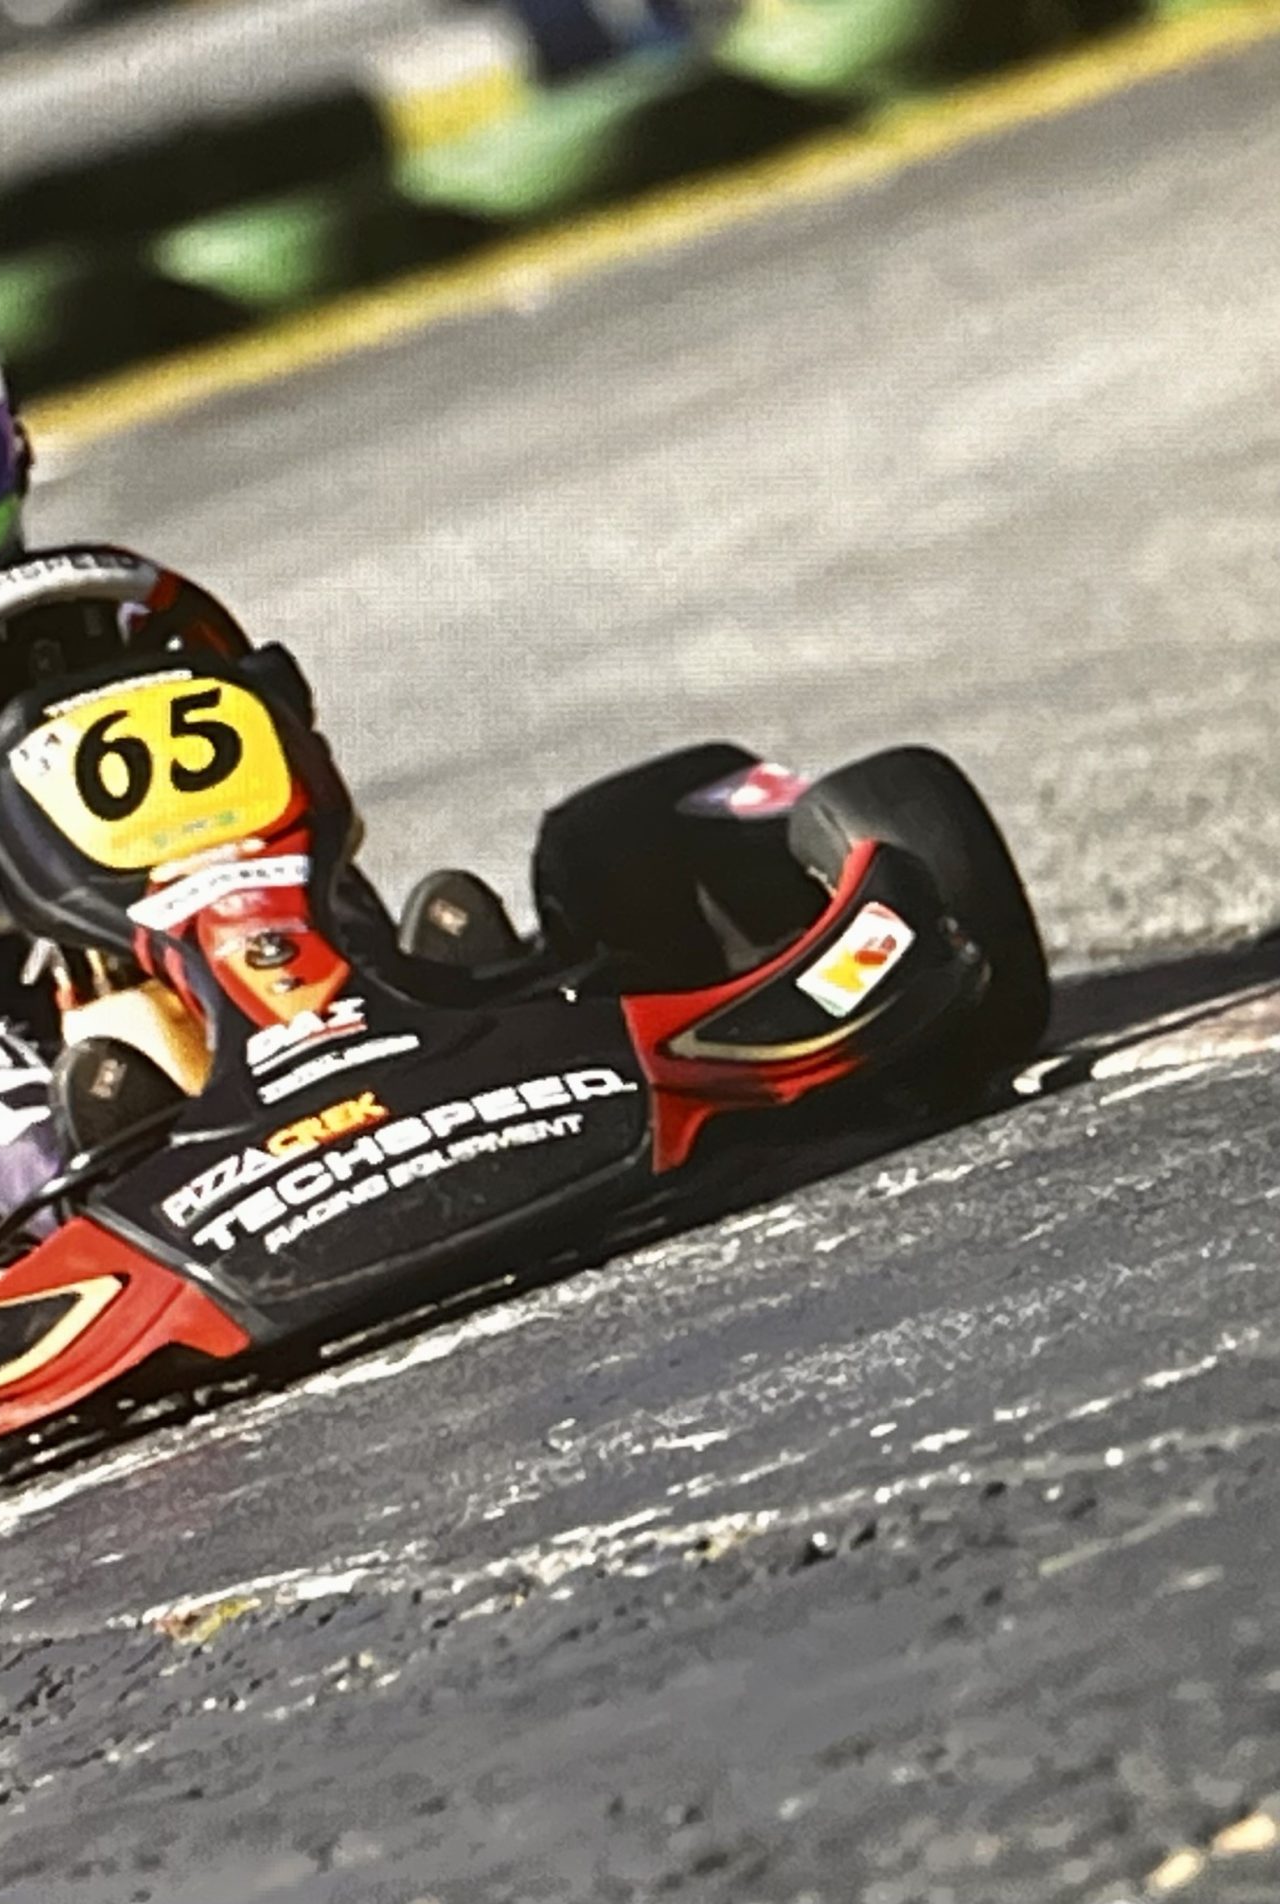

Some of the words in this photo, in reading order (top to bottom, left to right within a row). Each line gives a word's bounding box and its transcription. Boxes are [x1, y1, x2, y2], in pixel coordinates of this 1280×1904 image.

[74, 687, 243, 822] 65
[191, 1068, 639, 1251] TECHSPEED
[263, 1173, 390, 1255] RACING
